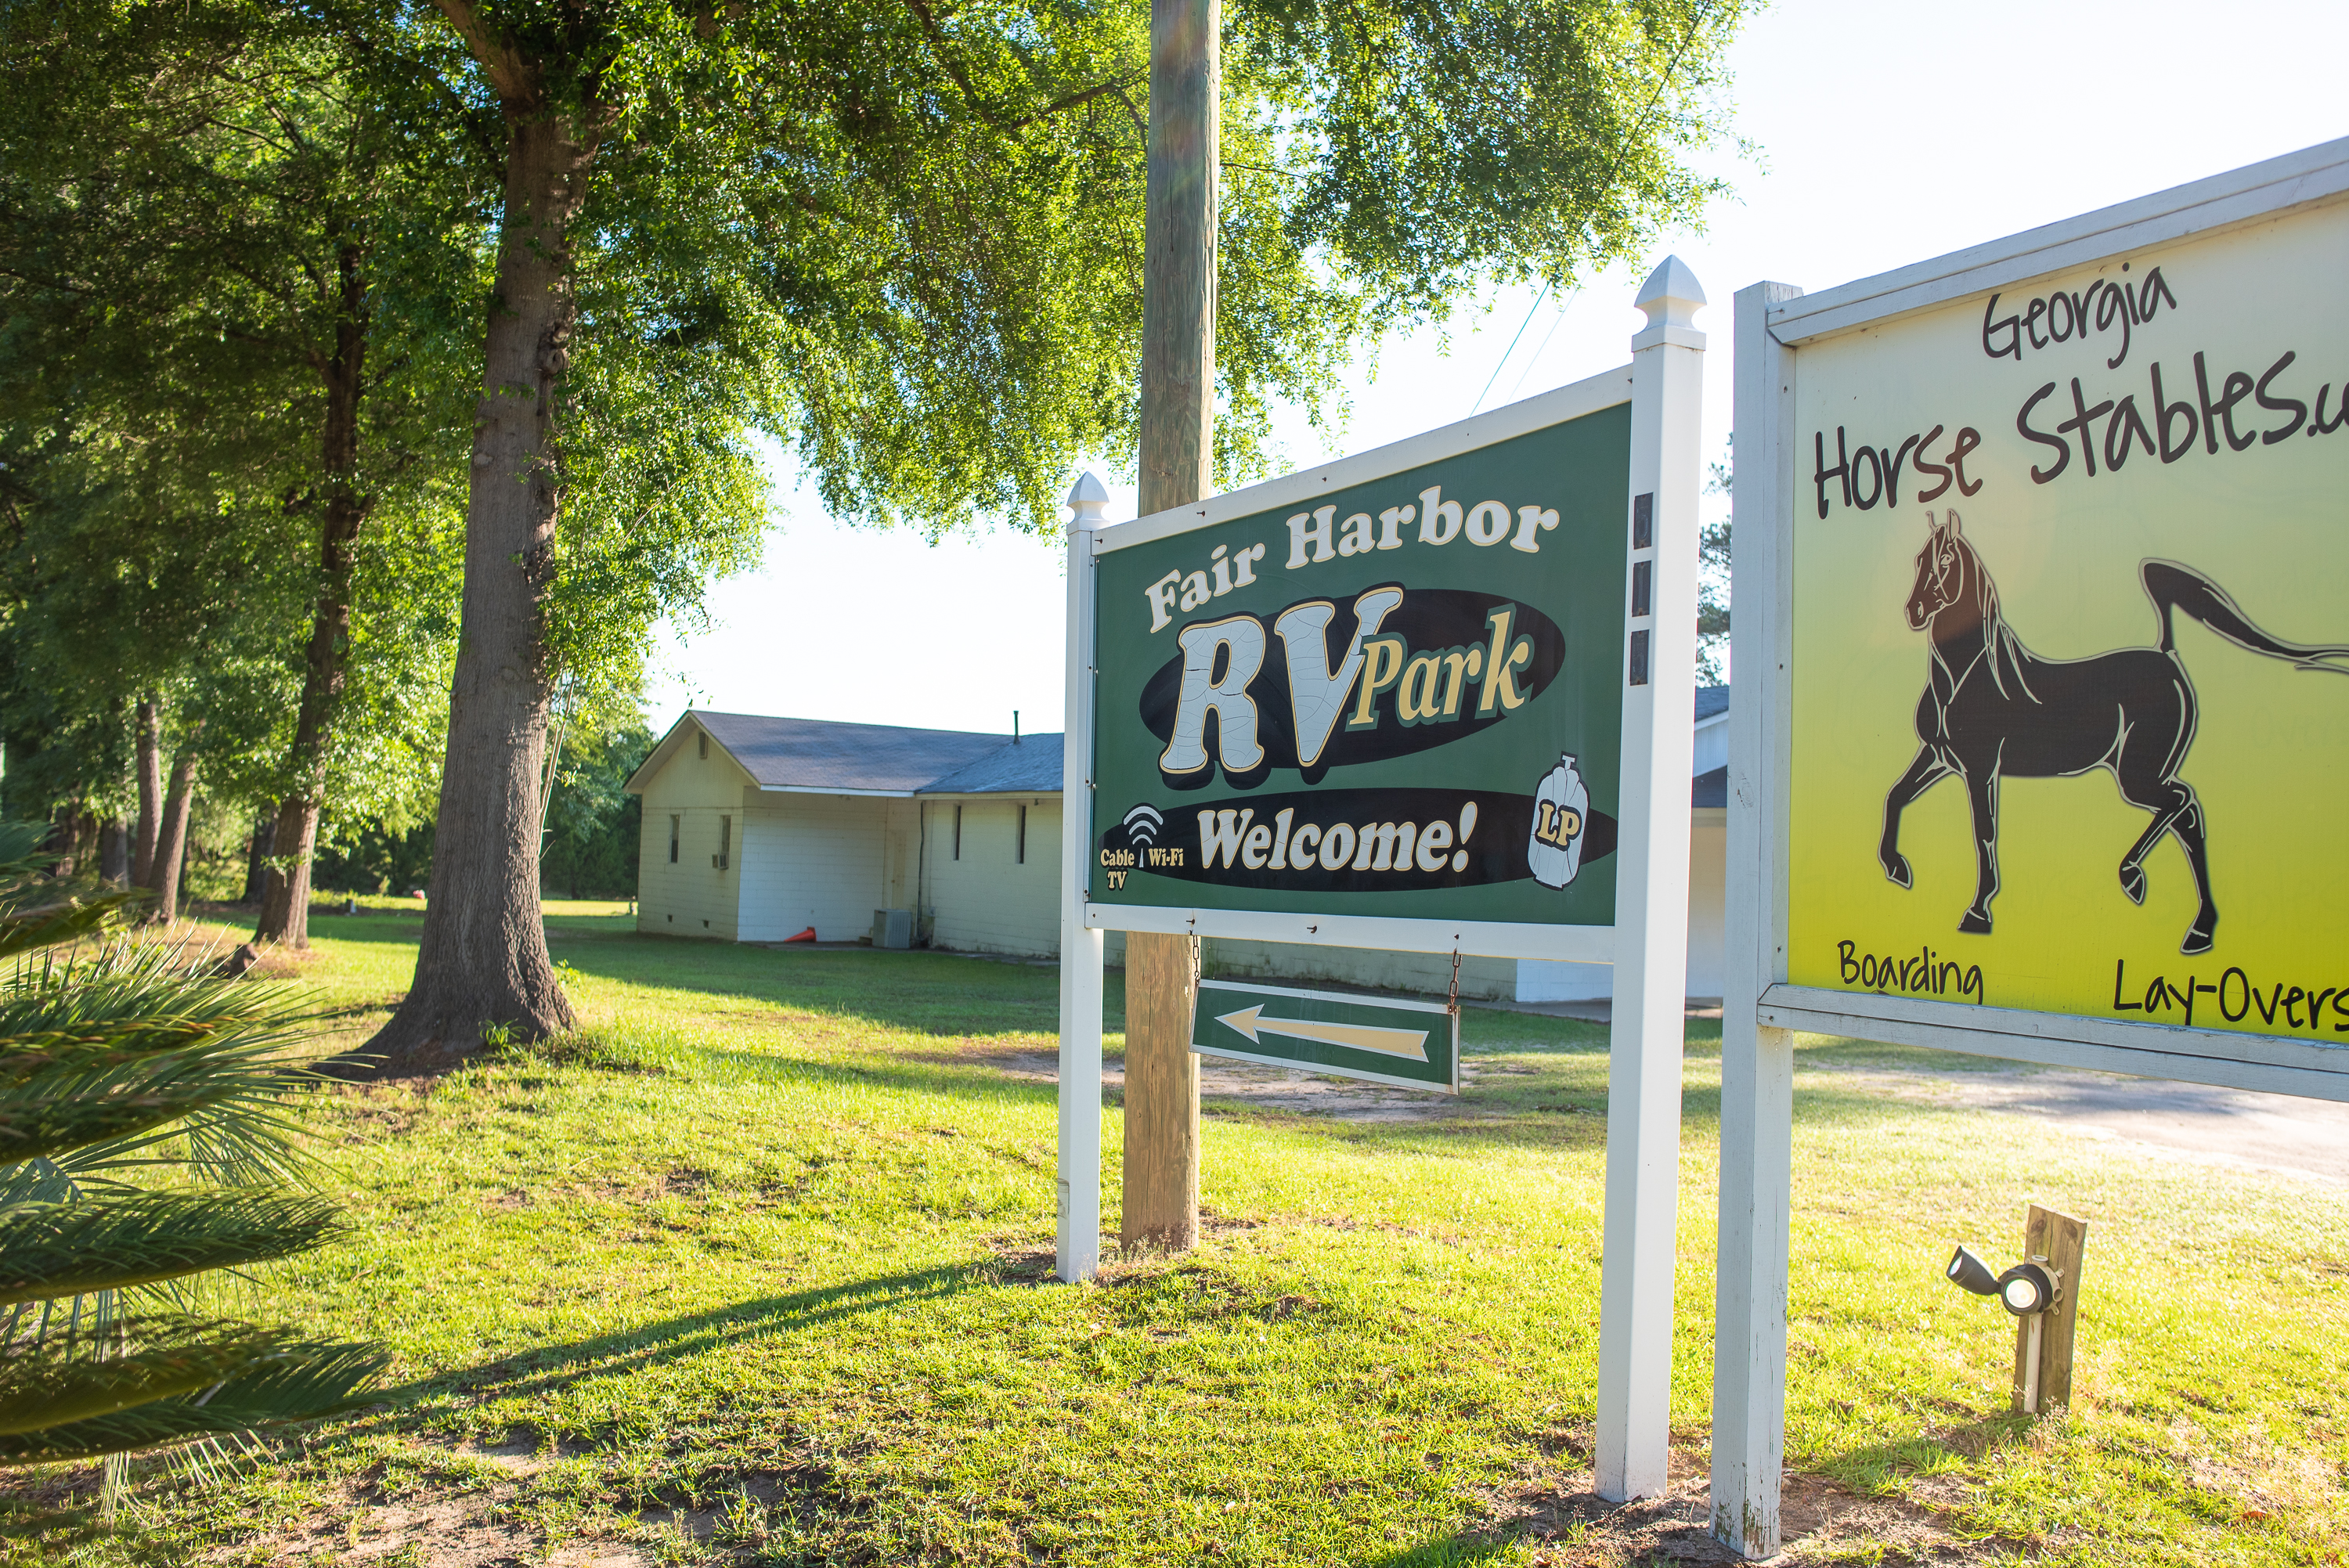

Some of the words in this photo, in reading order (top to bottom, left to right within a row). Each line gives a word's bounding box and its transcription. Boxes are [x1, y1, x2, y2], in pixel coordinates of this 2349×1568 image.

[1983, 262, 2177, 369] Georgia
[1814, 425, 1983, 520] Horse
[2016, 350, 2349, 485] Stables.c
[1145, 542, 1265, 633] Fair
[1285, 485, 1560, 569] Harbor
[1160, 586, 1404, 774] RV
[1348, 610, 1529, 726] Park
[1100, 849, 1135, 867] Cable
[1148, 848, 1183, 867] Wi-Fi
[1197, 802, 1478, 873] Welcome!
[1537, 803, 1580, 846] LP
[1107, 871, 1128, 889] TV
[1837, 939, 1984, 1005] Boarding
[2113, 958, 2349, 1033] Lay-Overs
